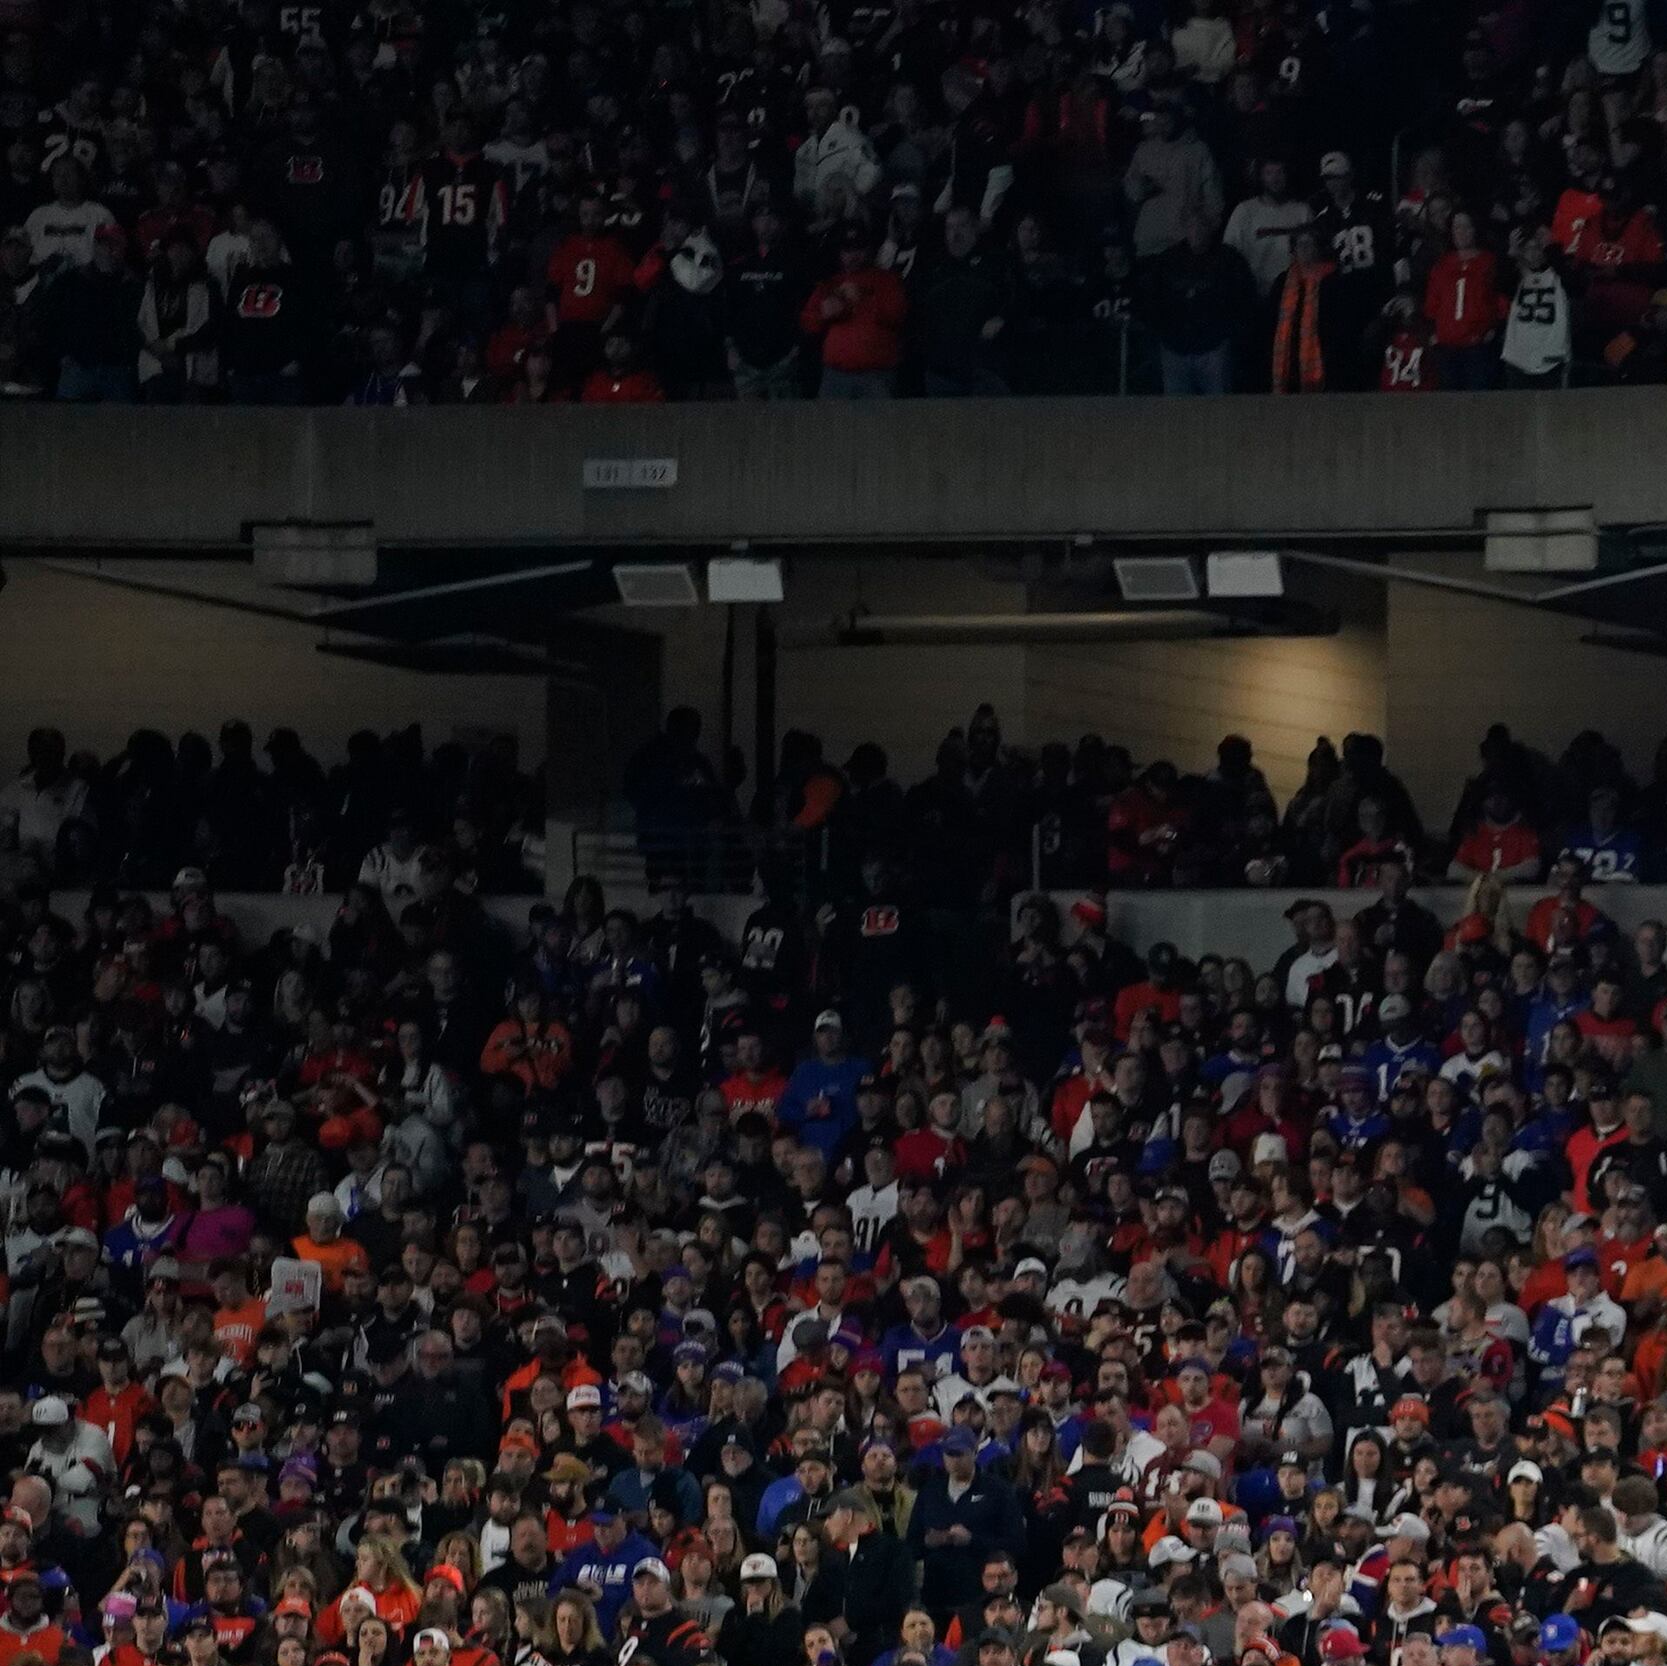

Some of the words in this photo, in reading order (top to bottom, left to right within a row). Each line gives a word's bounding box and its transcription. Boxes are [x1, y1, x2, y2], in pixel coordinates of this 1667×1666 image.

[439, 184, 478, 225] 15
[575, 259, 597, 297] 9
[1457, 279, 1465, 319] 1
[1385, 345, 1422, 386] 94
